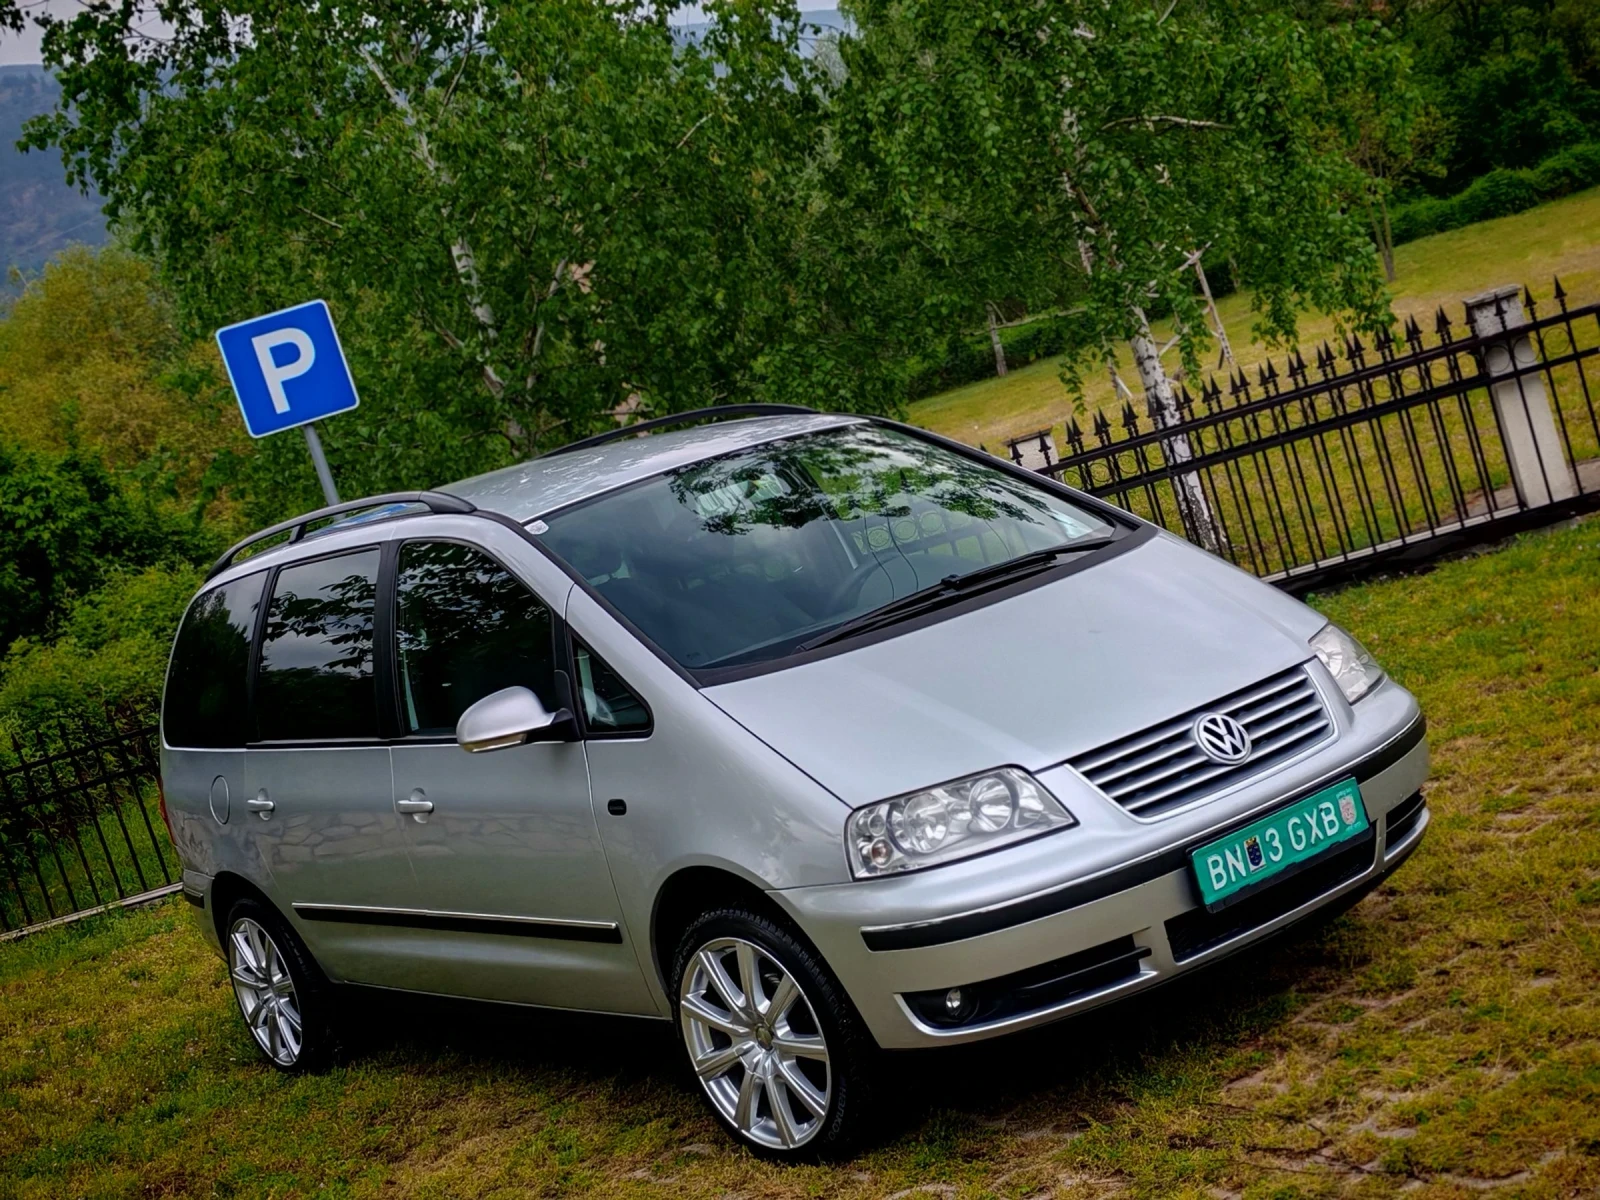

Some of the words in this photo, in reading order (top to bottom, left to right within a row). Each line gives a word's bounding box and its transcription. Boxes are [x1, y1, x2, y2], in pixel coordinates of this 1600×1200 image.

[251, 327, 316, 415] P
[1198, 714, 1248, 761] VW
[1206, 844, 1247, 891] BN
[1265, 827, 1284, 862] 3
[1287, 801, 1340, 851] GXB
